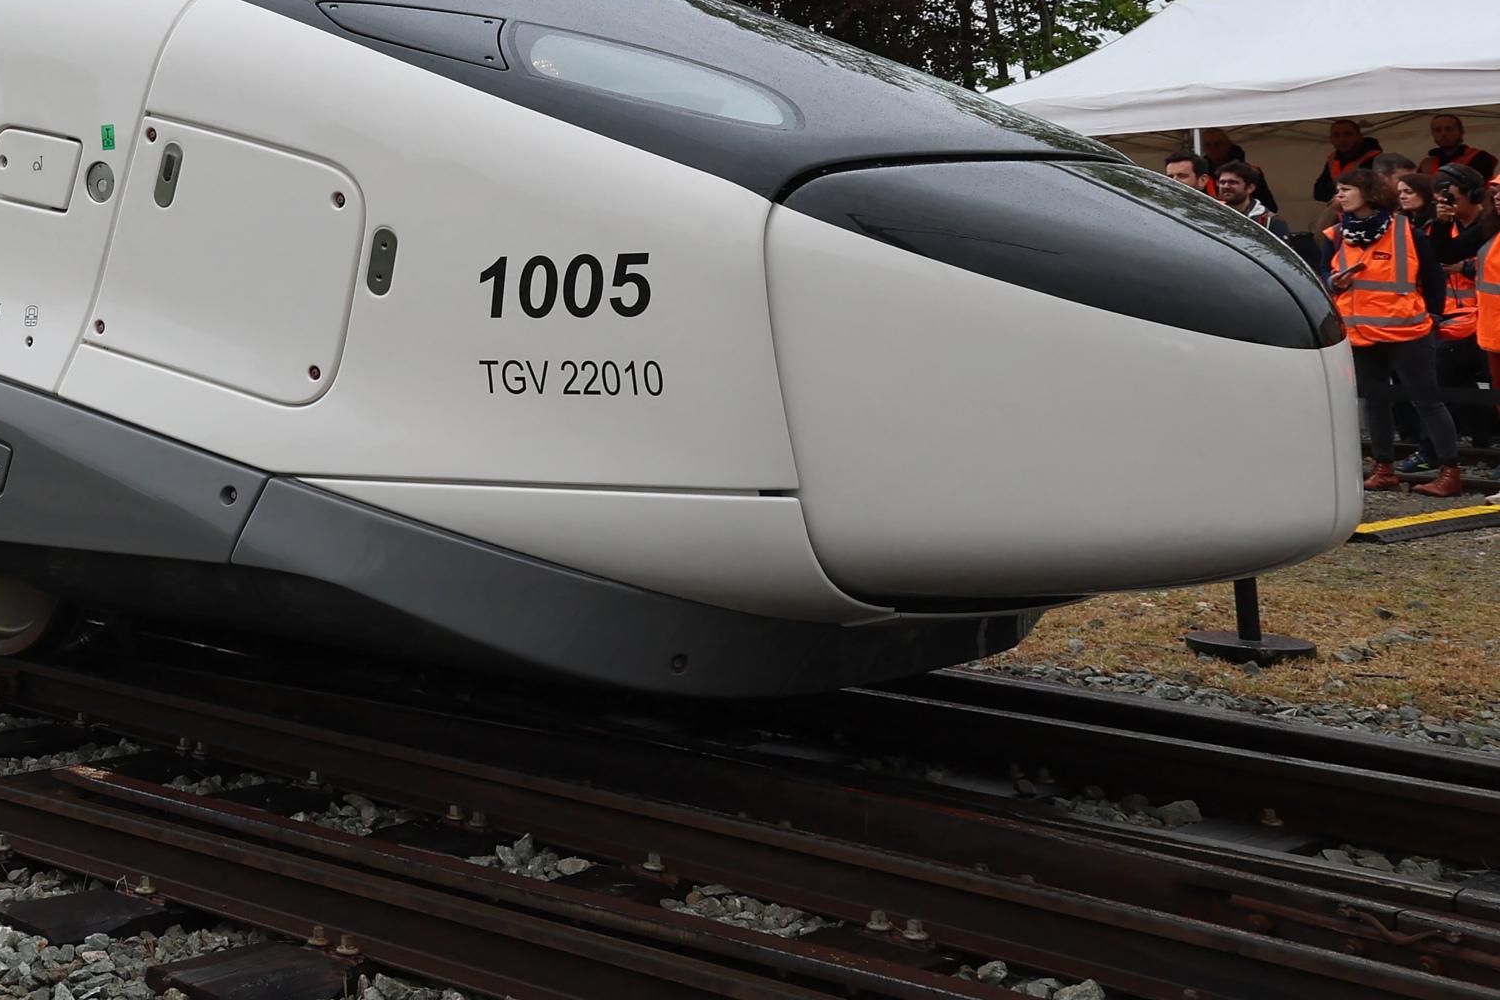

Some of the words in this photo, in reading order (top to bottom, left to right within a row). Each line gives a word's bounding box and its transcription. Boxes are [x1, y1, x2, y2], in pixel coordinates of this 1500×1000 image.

[480, 253, 651, 318] 1005
[479, 360, 548, 394] TGV
[560, 360, 663, 396] 22010
